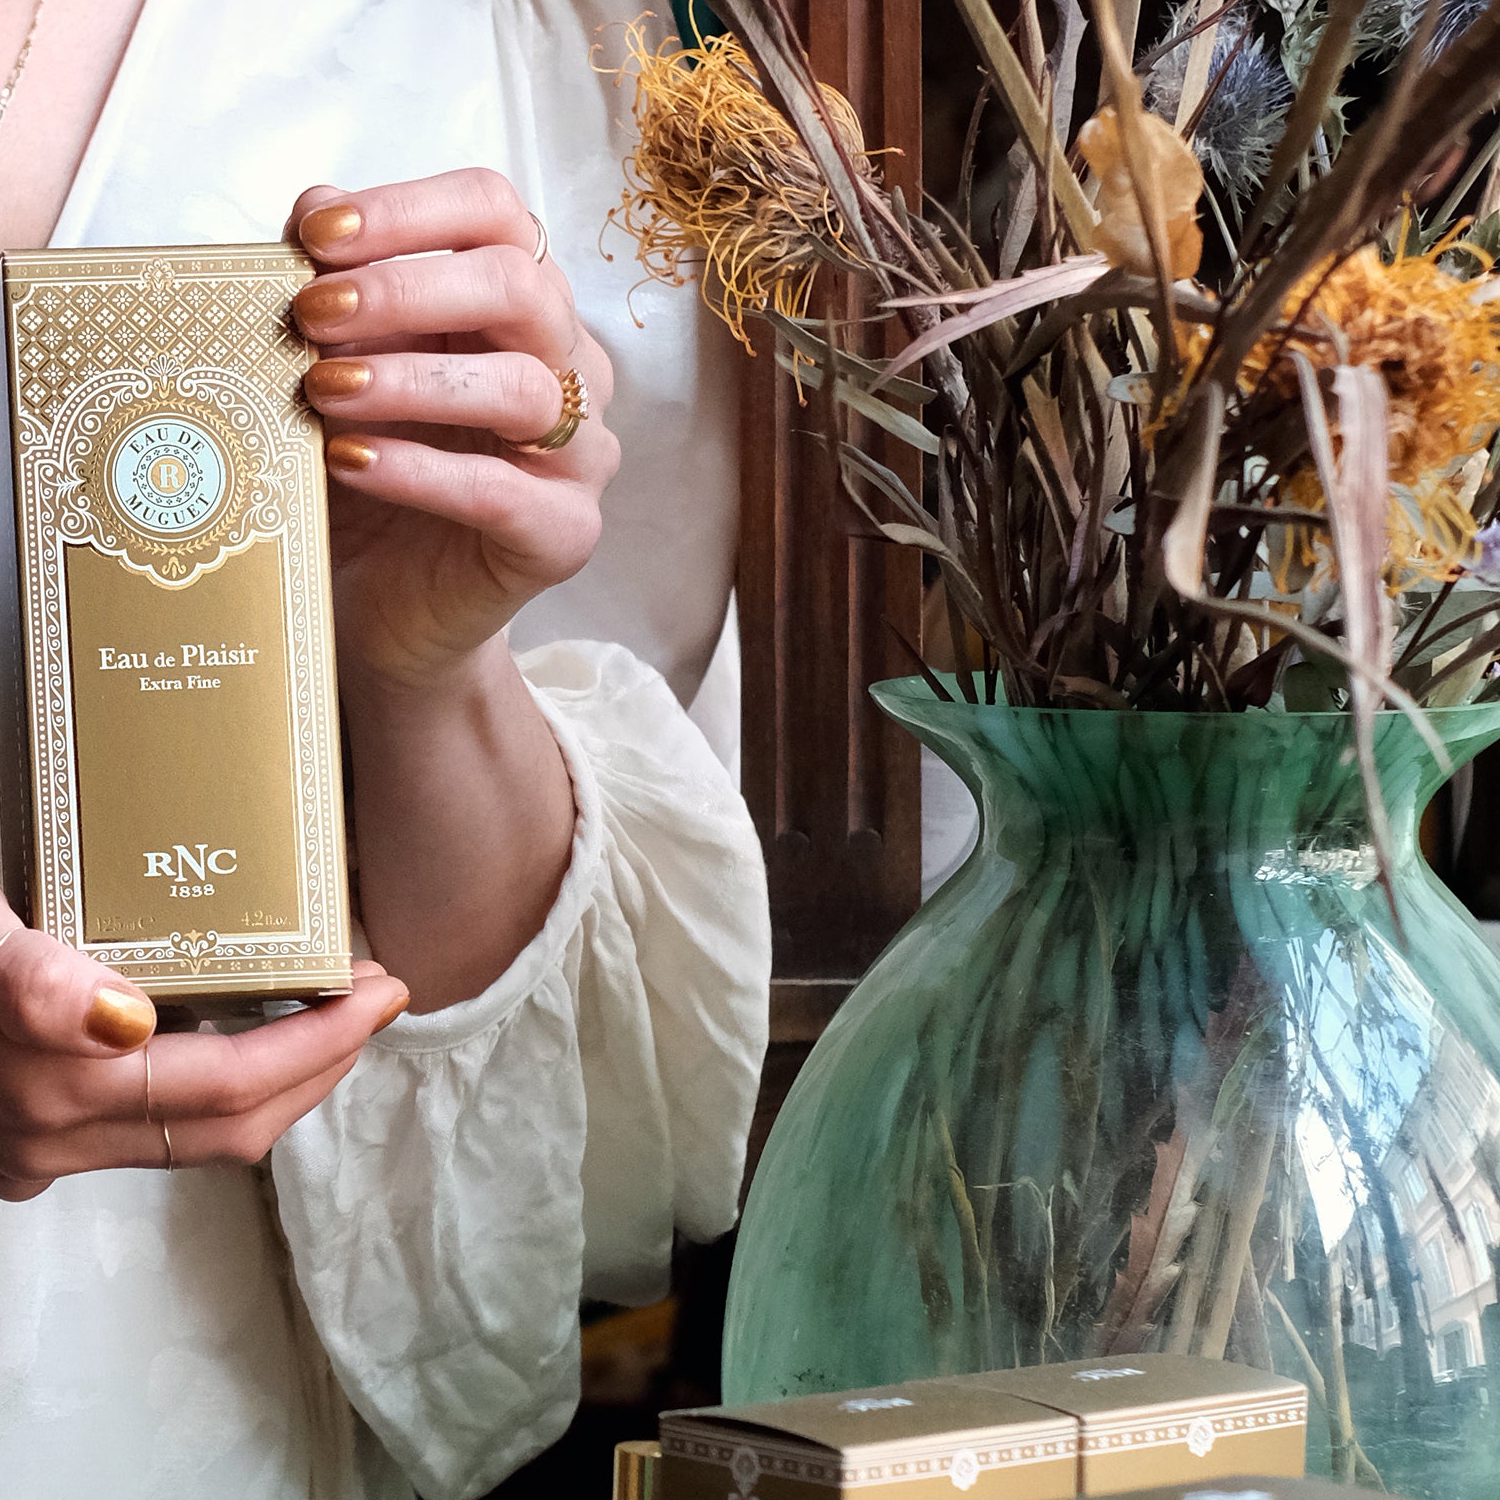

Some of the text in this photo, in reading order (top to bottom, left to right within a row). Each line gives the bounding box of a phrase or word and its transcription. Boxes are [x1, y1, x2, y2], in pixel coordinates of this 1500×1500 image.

[129, 427, 206, 455] EAU DE
[159, 463, 181, 488] R
[125, 493, 210, 526] MUGUET
[98, 642, 259, 670] Eau de Plaisir
[139, 674, 222, 691] Extra Fine
[142, 843, 238, 882] RNC
